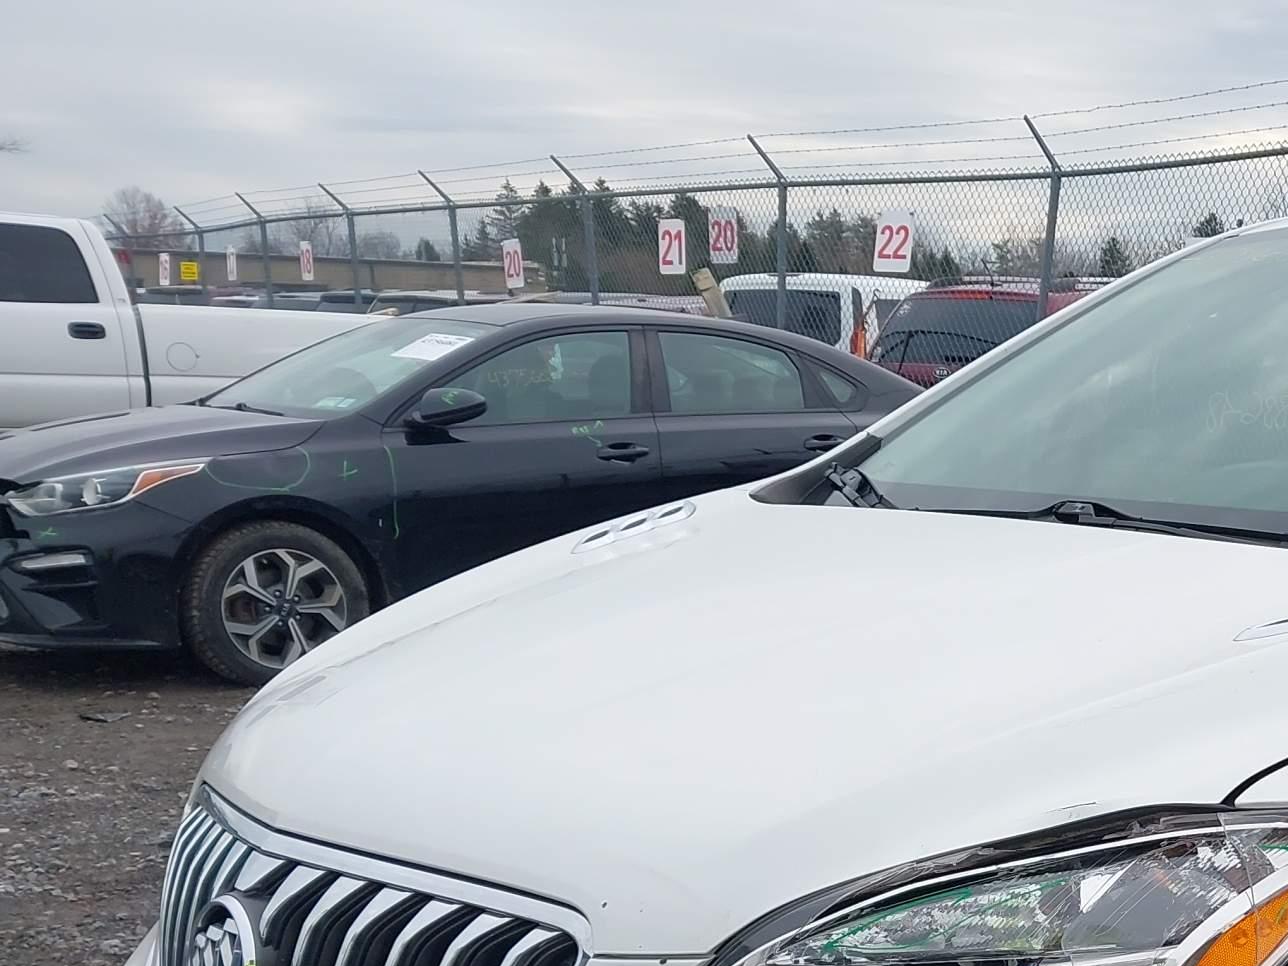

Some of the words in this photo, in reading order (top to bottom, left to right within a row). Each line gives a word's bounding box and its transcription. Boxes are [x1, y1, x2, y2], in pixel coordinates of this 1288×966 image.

[661, 229, 683, 266] 21
[711, 219, 736, 252] 20
[877, 224, 910, 260] 22
[504, 250, 522, 279] 20
